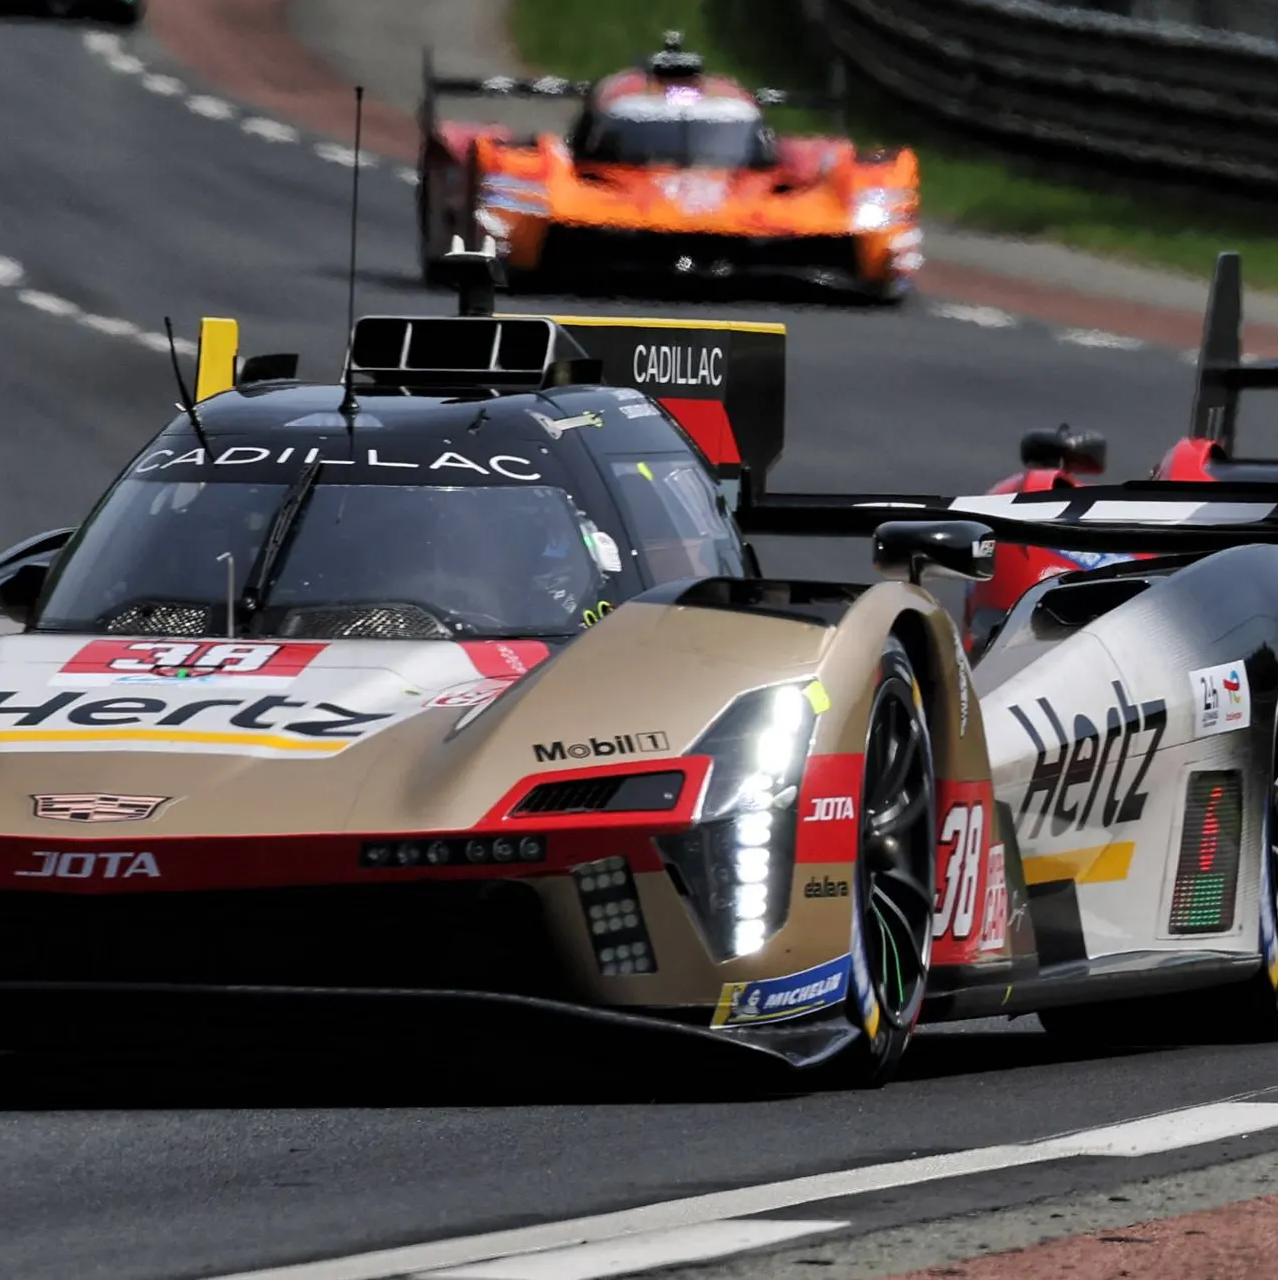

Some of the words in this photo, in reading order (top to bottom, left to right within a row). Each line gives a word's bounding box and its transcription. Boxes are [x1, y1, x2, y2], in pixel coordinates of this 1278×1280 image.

[633, 344, 723, 386] CADILLAC
[134, 447, 542, 481] CADILLAC
[109, 642, 283, 672] 38
[532, 734, 635, 762] Mobil
[1007, 679, 1168, 841] Hertz
[804, 797, 854, 821] JOTA
[14, 851, 162, 878] JOTA
[932, 804, 984, 937] 38
[763, 972, 843, 1010] MICHELIN
